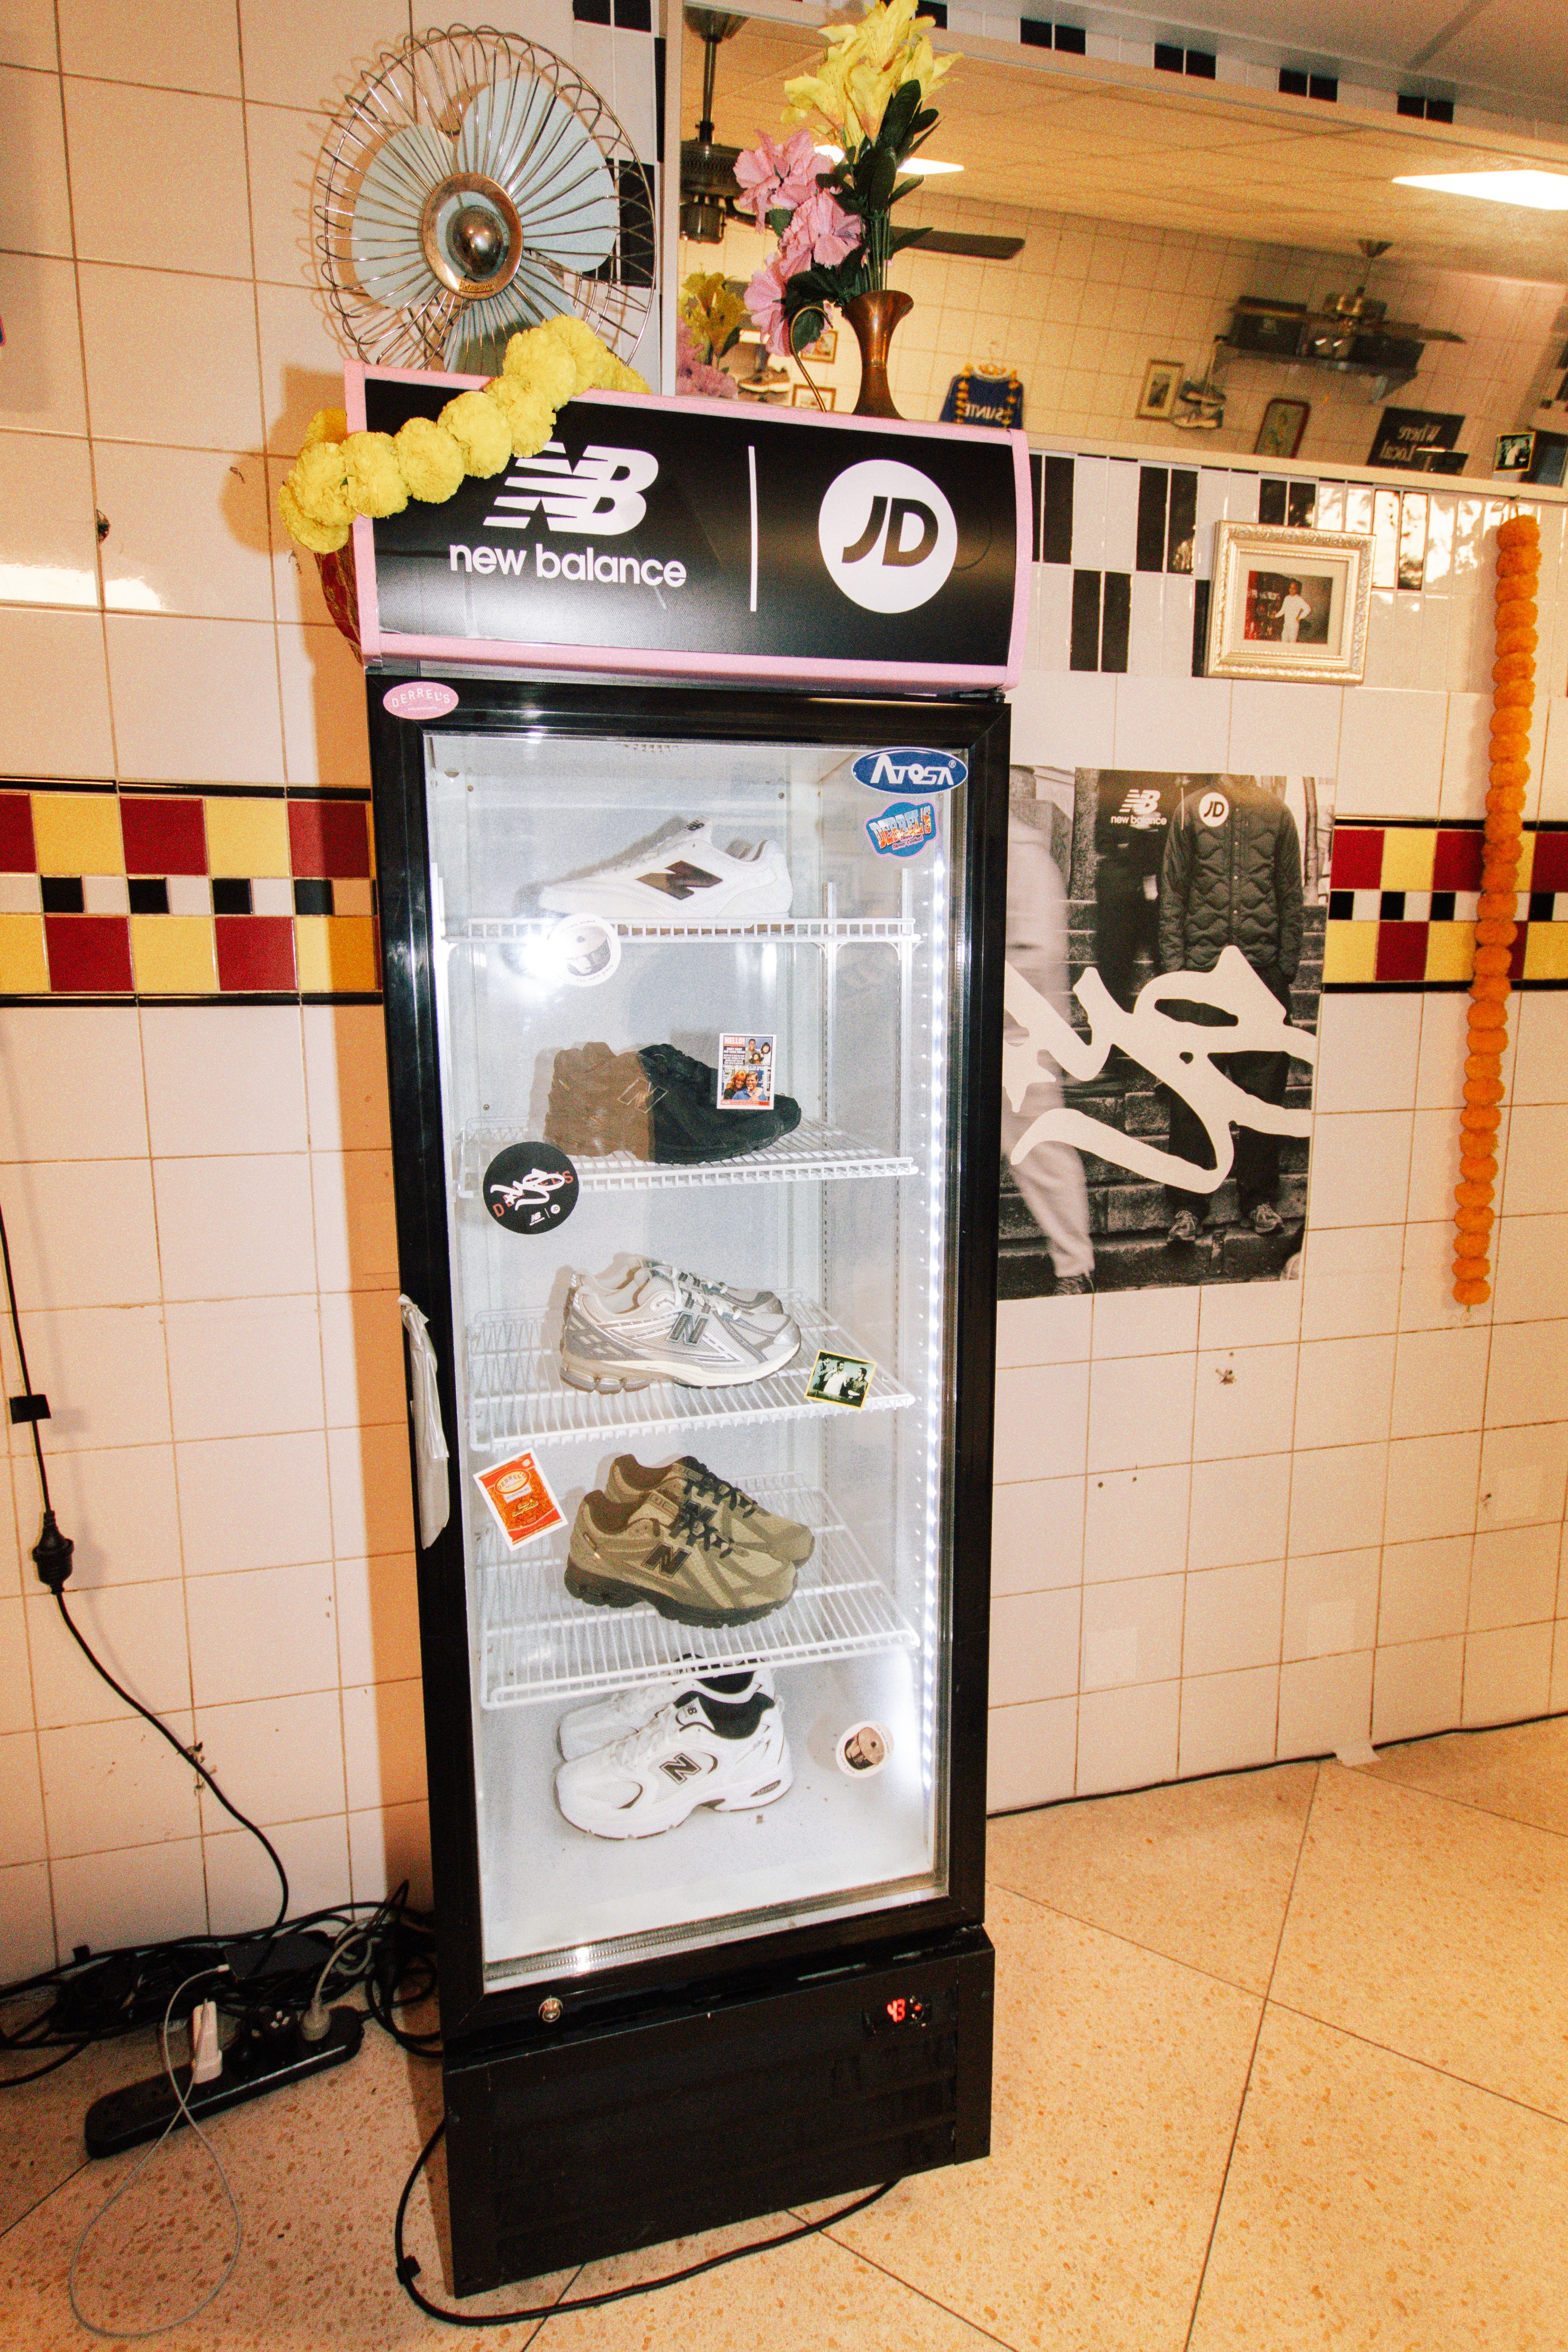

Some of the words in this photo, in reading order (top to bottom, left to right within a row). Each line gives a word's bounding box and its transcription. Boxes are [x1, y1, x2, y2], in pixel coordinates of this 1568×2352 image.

[842, 496, 938, 567] JD
[450, 544, 526, 575] new
[536, 543, 686, 587] balance
[391, 687, 450, 707] DERREL'S
[1204, 800, 1225, 817] JD
[869, 805, 931, 849] DERREL'S
[1111, 815, 1128, 824] new
[725, 1036, 745, 1045] HELLO!
[497, 1472, 526, 1490] DERREL'S
